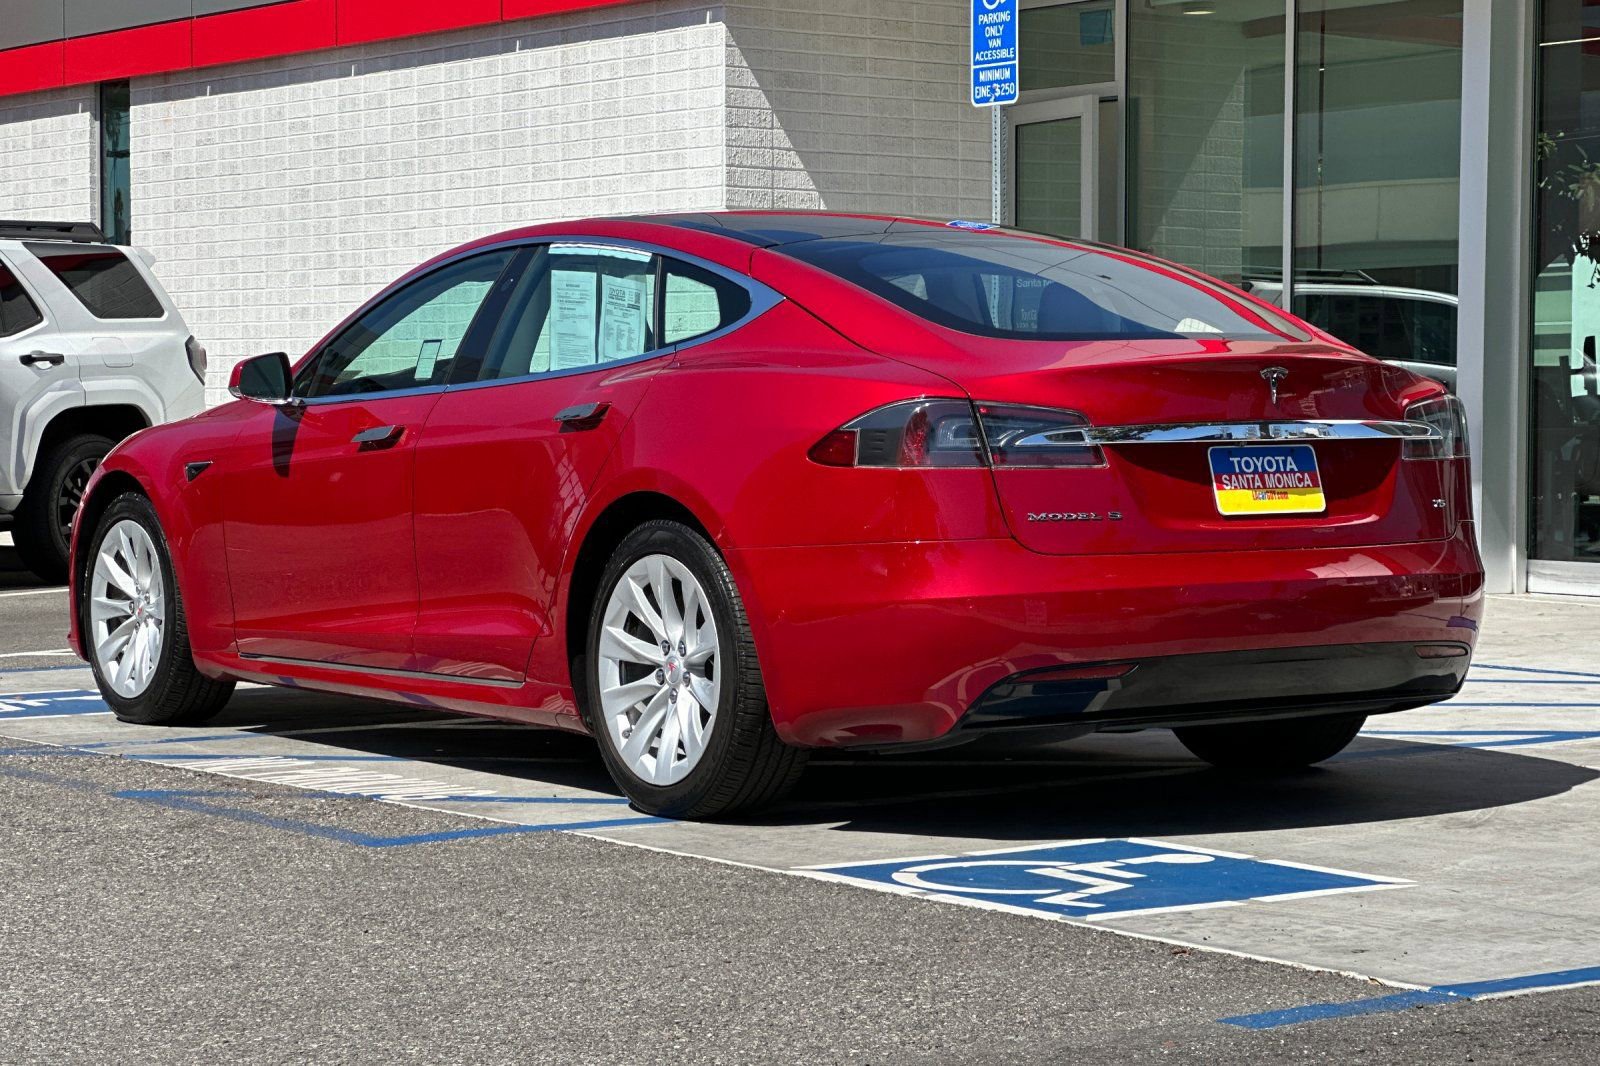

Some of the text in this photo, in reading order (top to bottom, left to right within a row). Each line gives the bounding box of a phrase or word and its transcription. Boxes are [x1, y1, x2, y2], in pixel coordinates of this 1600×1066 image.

[979, 11, 1010, 24] PARKING
[985, 25, 1004, 37] ONLY
[988, 38, 1001, 48] VAN
[975, 48, 1014, 61] ACCESSIBLE
[979, 68, 1010, 81] MINIMUM
[1230, 456, 1298, 472] TOYOTA
[1221, 472, 1312, 490] SANTA MONICA
[1027, 511, 1122, 522] MODEL S
